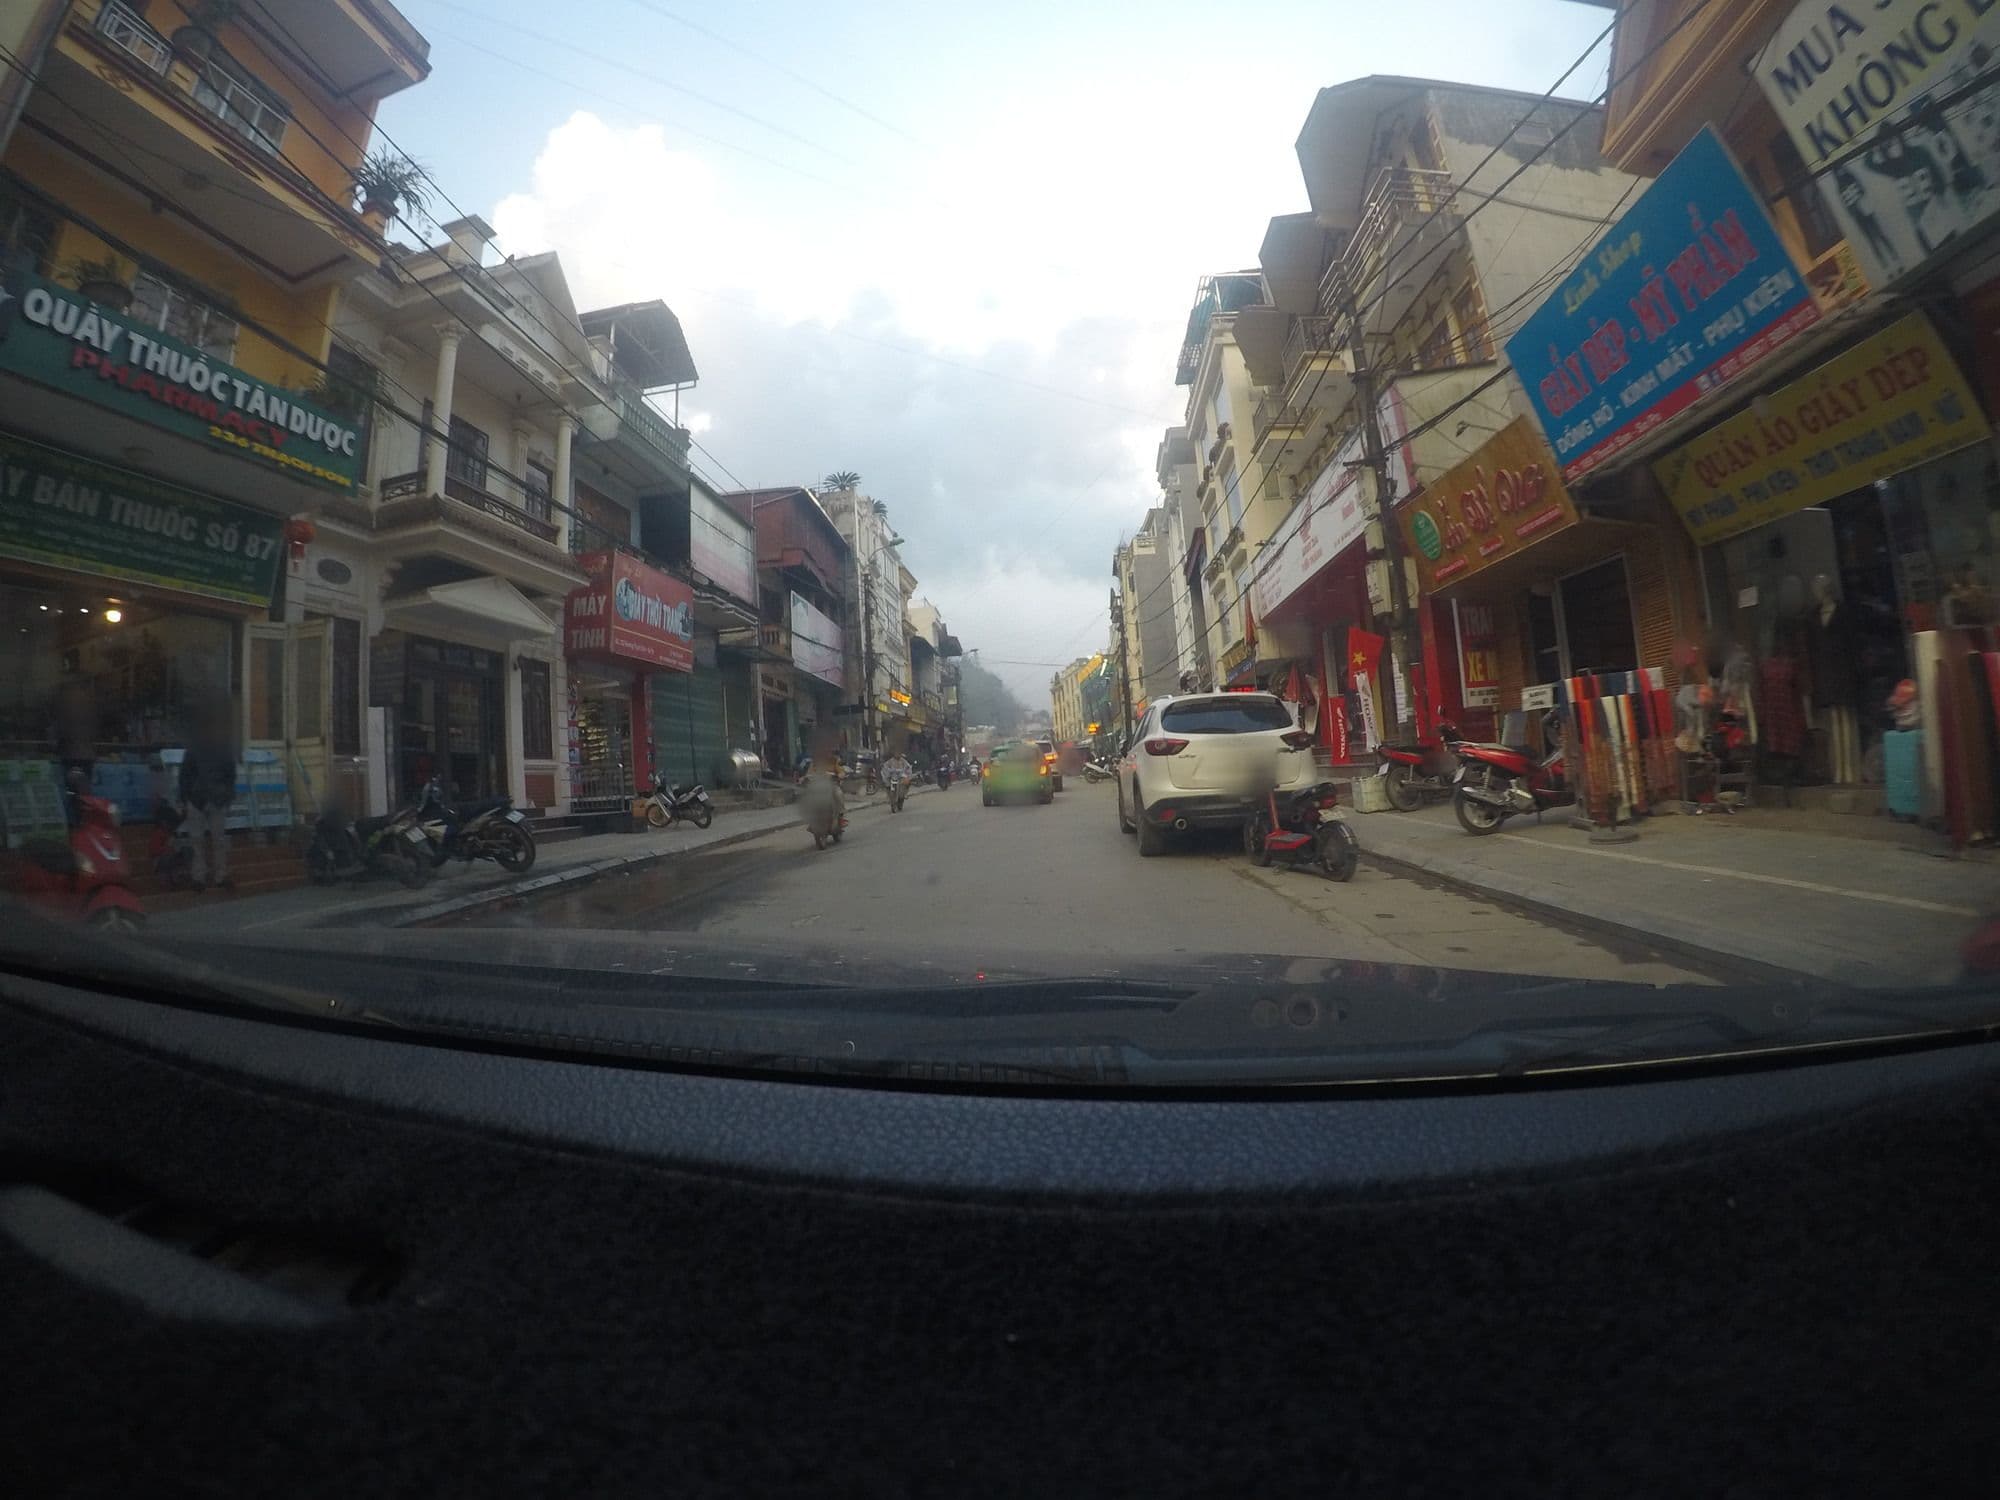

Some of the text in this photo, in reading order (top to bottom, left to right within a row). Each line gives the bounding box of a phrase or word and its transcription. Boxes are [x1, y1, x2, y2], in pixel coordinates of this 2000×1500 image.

[1771, 2, 1865, 105] MUA
[1803, 2, 1961, 161] KHÔNG
[23, 288, 357, 458] QUẦY THUỐC TÂN DƯỢC
[71, 346, 289, 448] PHARMACY
[33, 474, 101, 516] BÁN
[110, 494, 199, 542] THUỐC
[205, 519, 244, 552] SỐ
[245, 534, 275, 561] 87
[572, 625, 606, 649] TÍNH
[573, 592, 607, 617] MÁY
